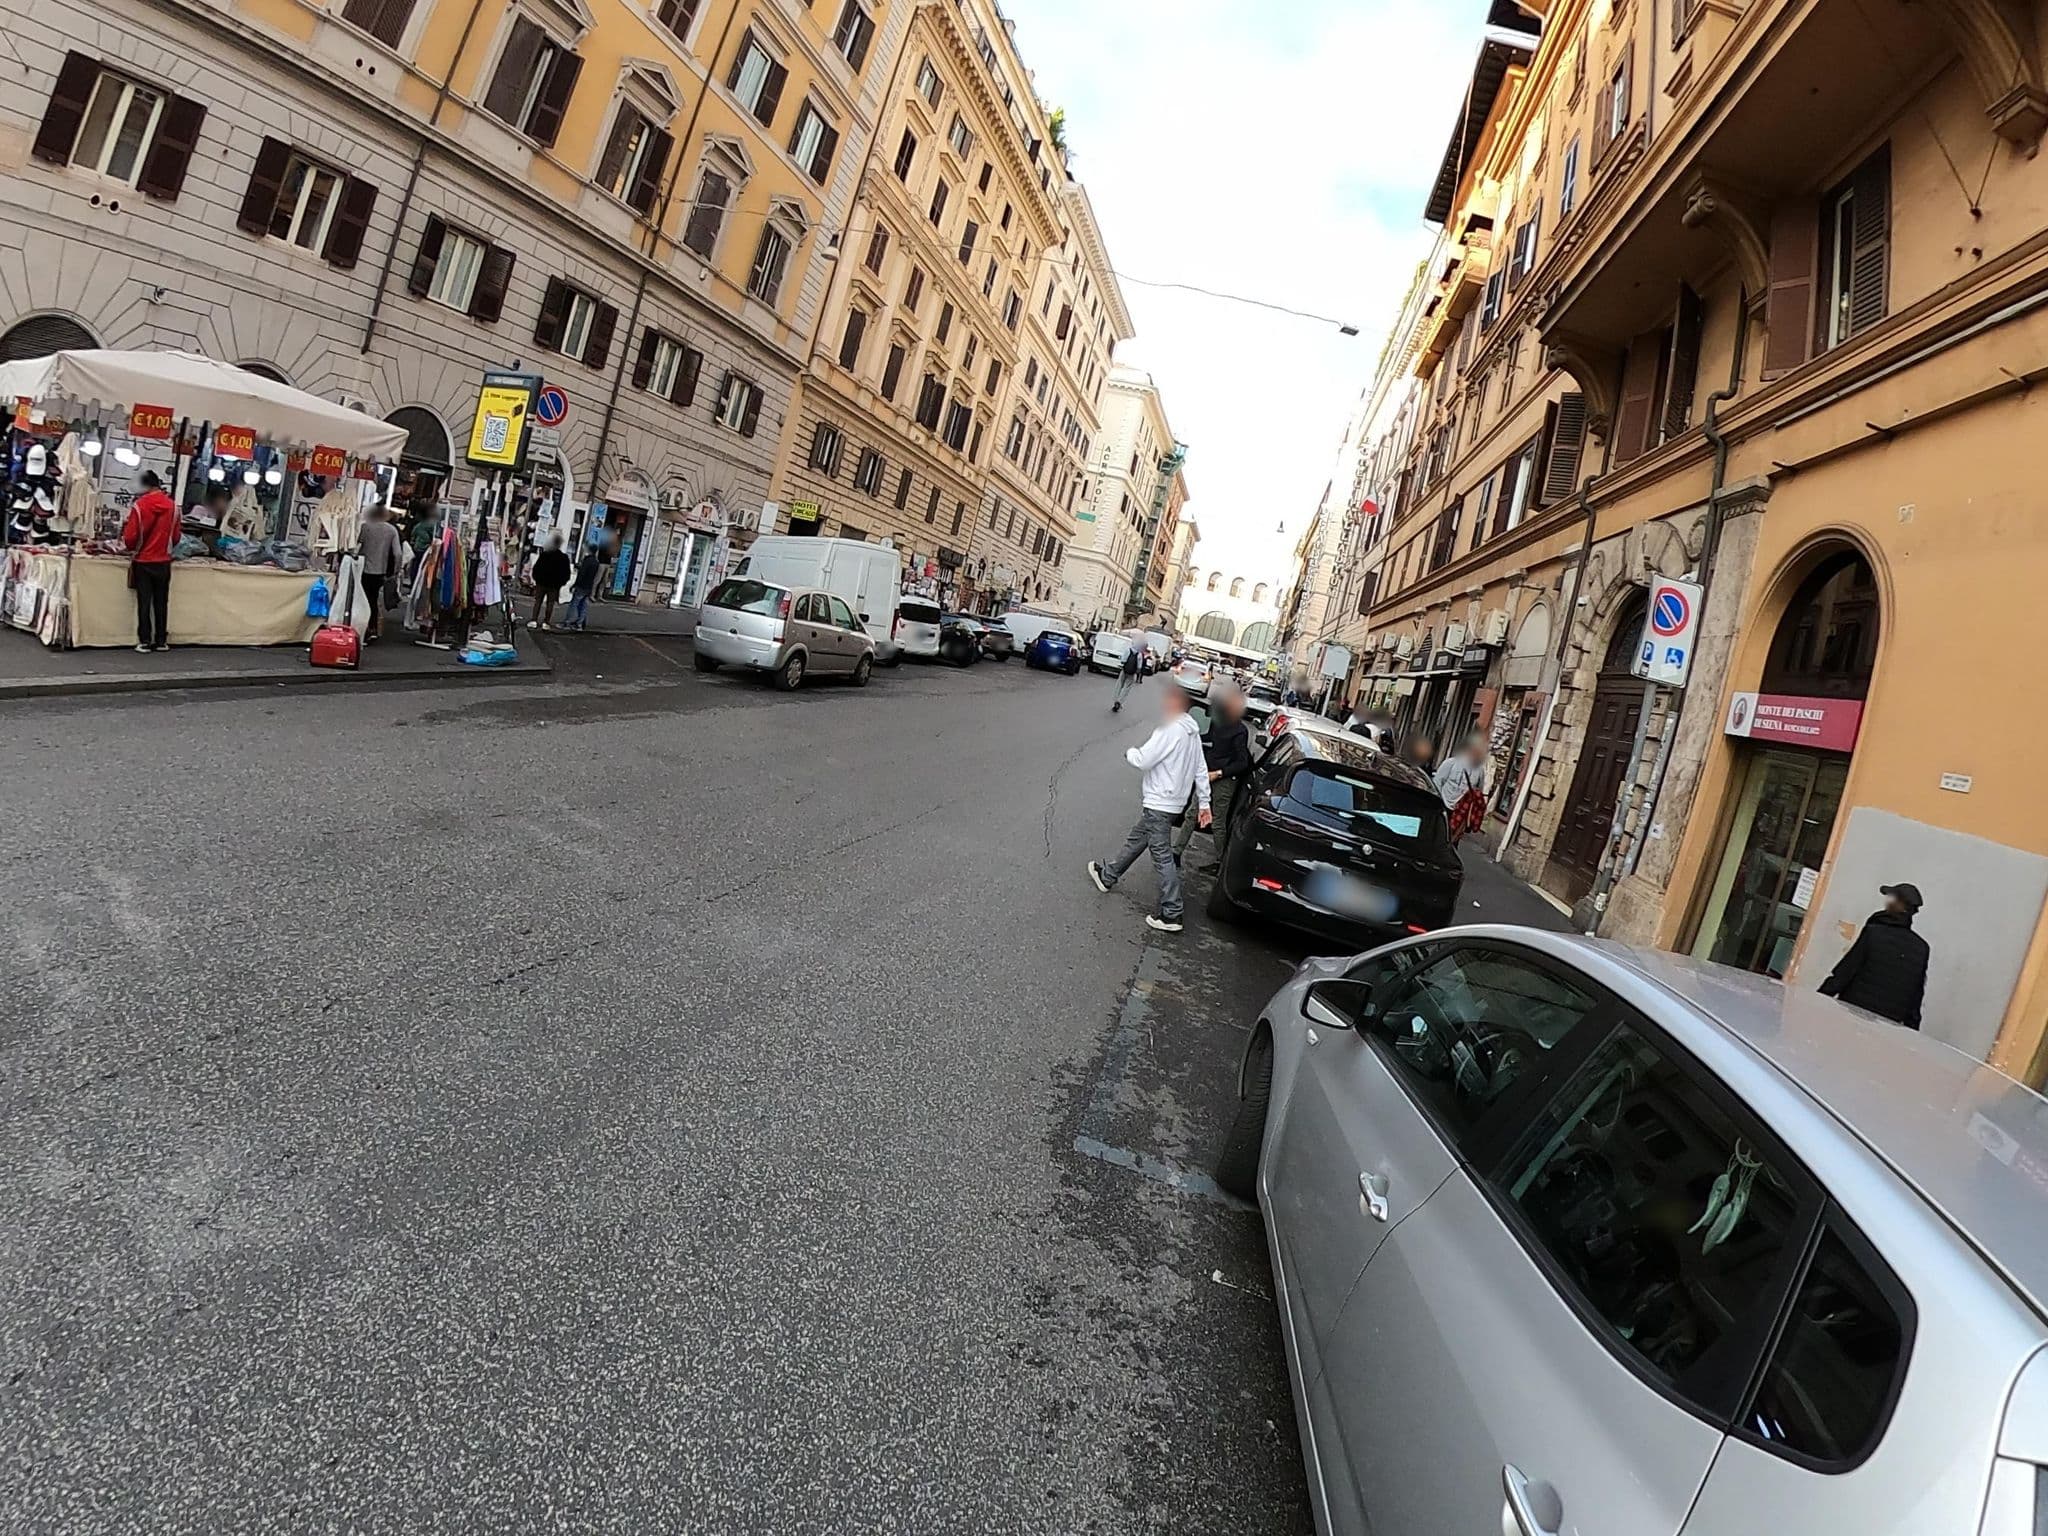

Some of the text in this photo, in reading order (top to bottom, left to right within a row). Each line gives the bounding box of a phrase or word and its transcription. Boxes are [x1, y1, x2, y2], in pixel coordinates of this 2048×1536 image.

[1091, 445, 1111, 512] ACROPOLI
[1757, 704, 1825, 721] MONTE DEI PASCHI
[1762, 719, 1782, 731] SIENA
